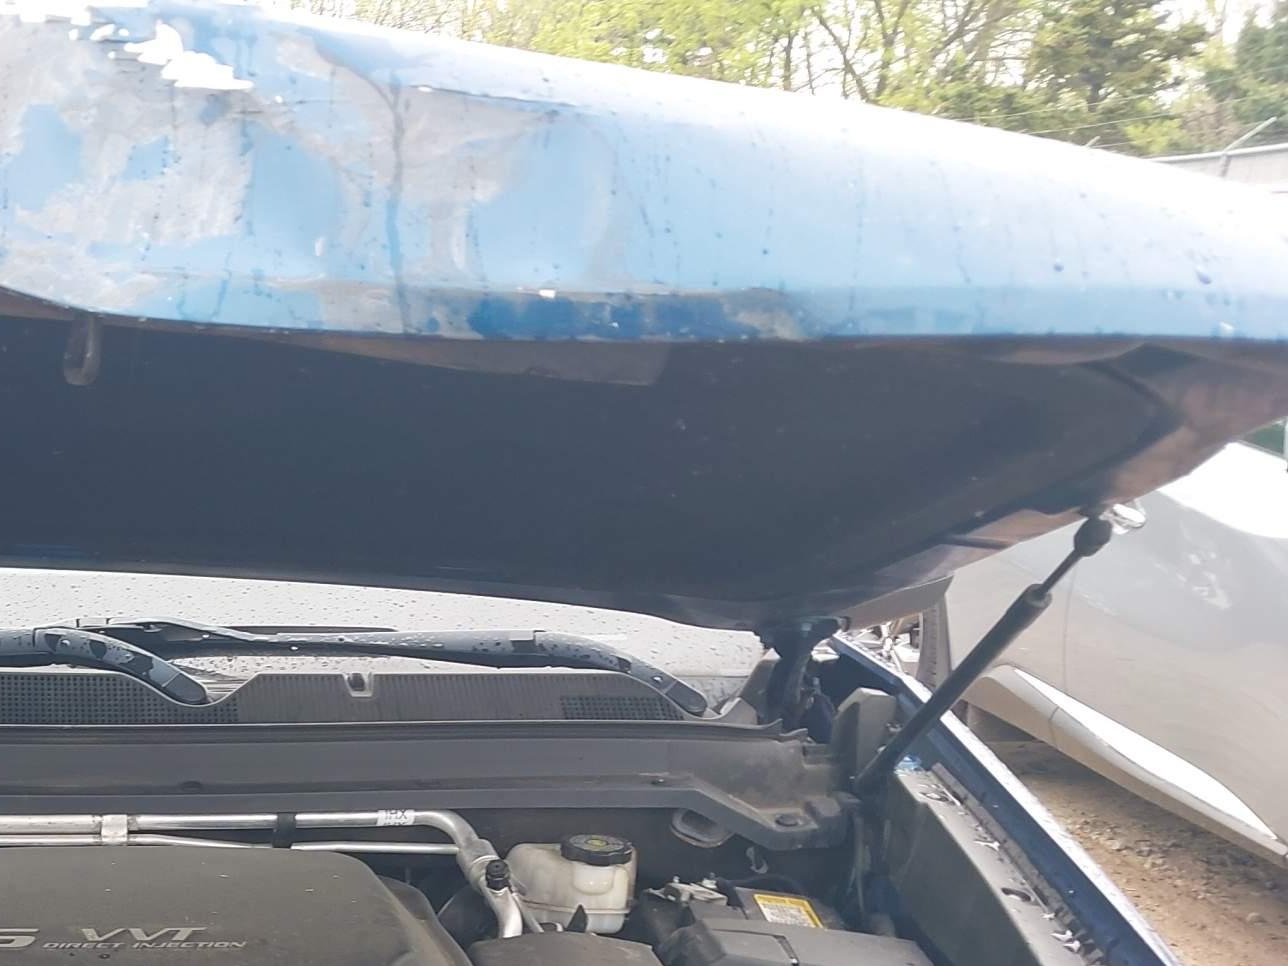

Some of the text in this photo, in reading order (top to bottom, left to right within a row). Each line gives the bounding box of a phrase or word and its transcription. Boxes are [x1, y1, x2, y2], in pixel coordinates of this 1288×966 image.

[81, 926, 208, 942] VVT
[42, 940, 247, 950] DIRECT INJECTION
